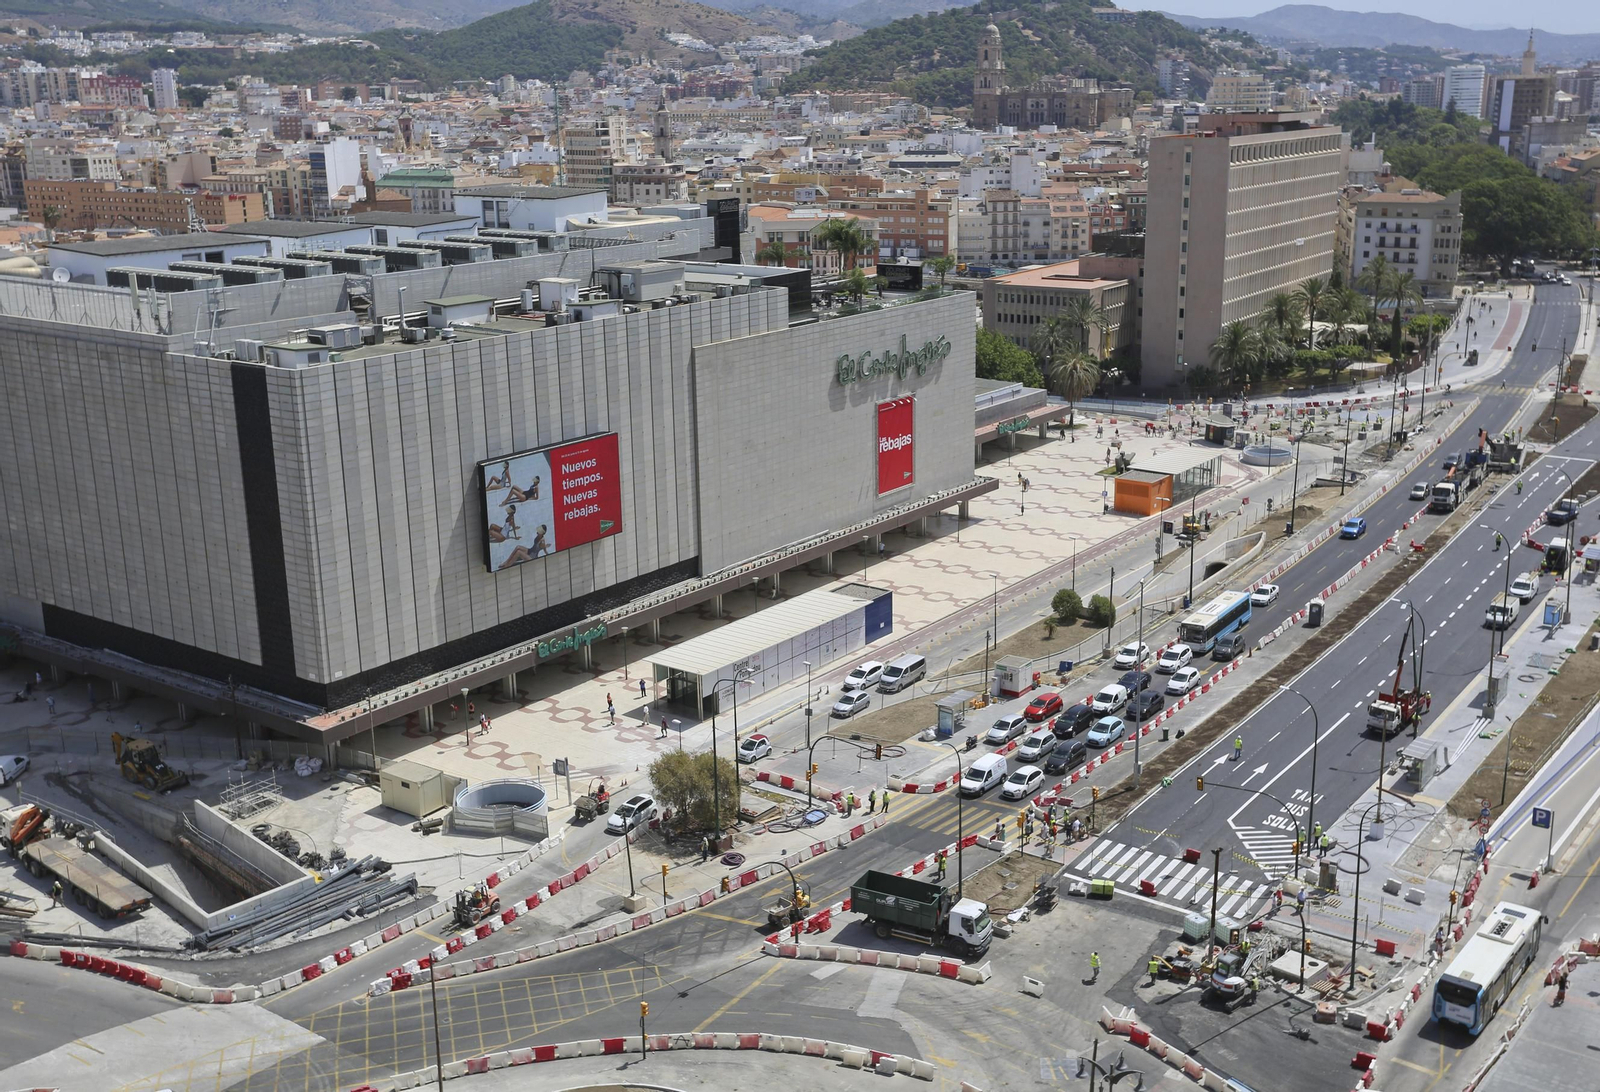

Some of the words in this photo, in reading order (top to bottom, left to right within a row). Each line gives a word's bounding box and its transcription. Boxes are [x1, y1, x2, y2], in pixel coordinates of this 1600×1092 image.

[838, 353, 856, 385] El
[859, 350, 897, 379] Corte
[899, 333, 952, 381] Inglés
[879, 433, 912, 453] rebajas
[561, 458, 597, 475] Nuevos
[562, 472, 604, 490] tiempos.
[563, 488, 598, 506] Nuevas
[564, 504, 601, 521] rebajas.
[537, 641, 549, 658] El
[549, 637, 574, 653] Corte
[573, 623, 607, 651] Inglés
[1290, 788, 1325, 805] TAXI
[1279, 802, 1309, 817] BUS
[1535, 810, 1546, 822] P
[1261, 814, 1301, 832] SOLO
